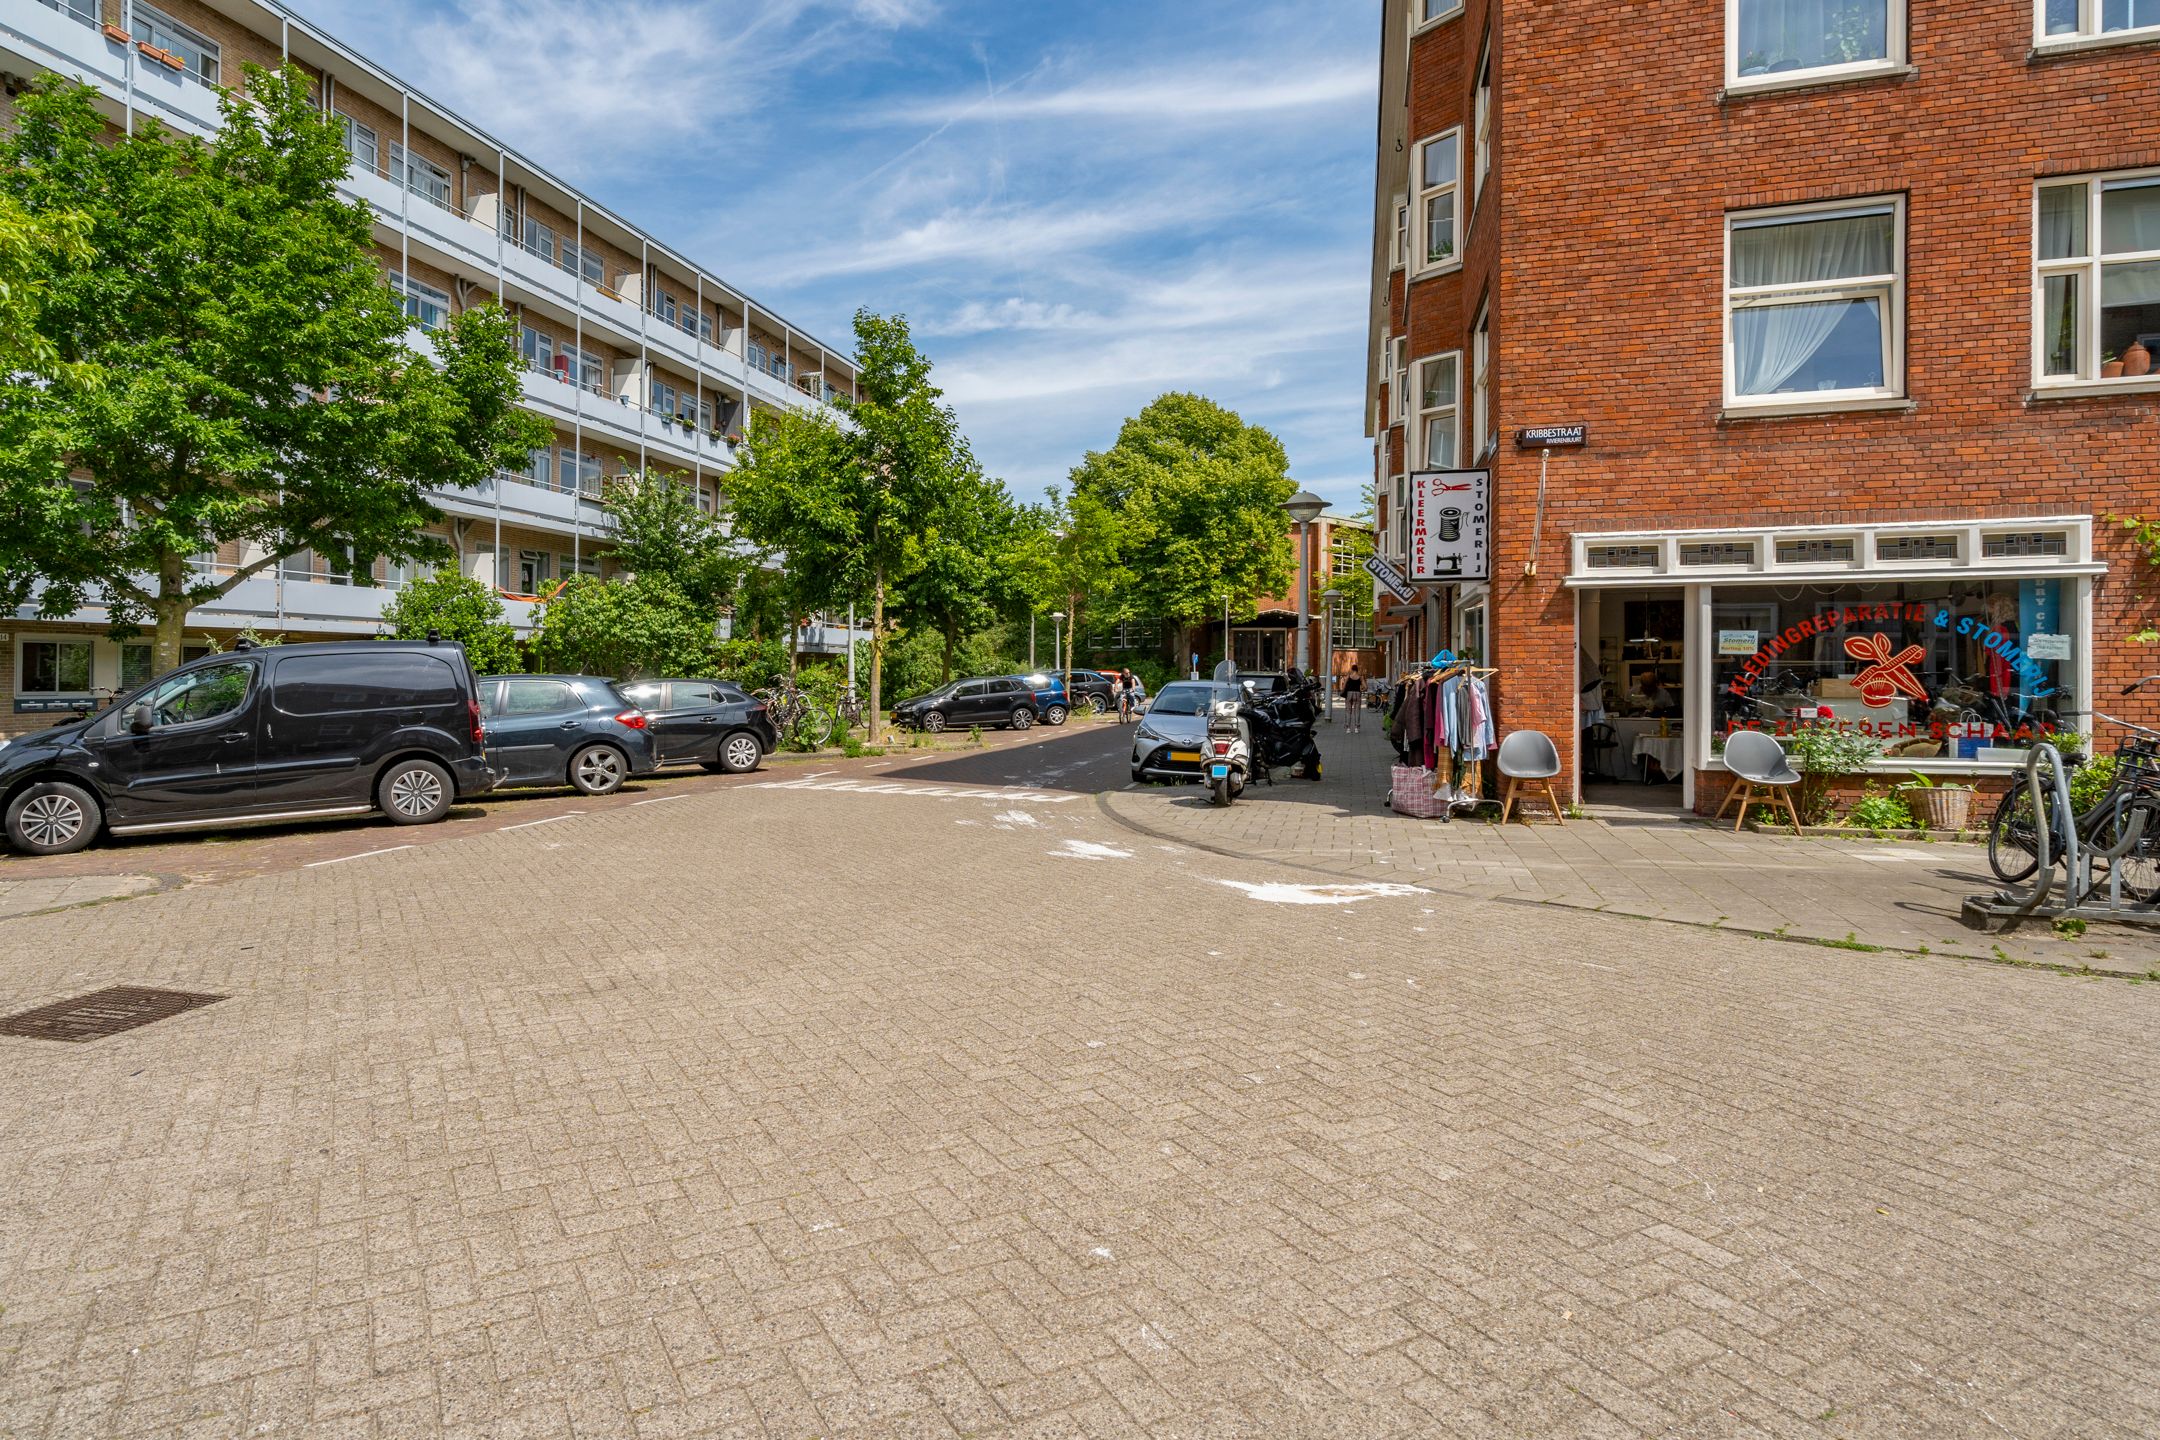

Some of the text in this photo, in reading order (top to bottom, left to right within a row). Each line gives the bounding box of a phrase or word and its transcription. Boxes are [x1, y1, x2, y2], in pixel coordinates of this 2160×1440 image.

[1526, 426, 1583, 439] KRIBBESTRAAT
[1414, 480, 1427, 574] KLEERMAKER
[1472, 478, 1485, 573] STOMERIJ
[1728, 602, 2056, 697] KLEDINGREPARATIE & STOMERIJ
